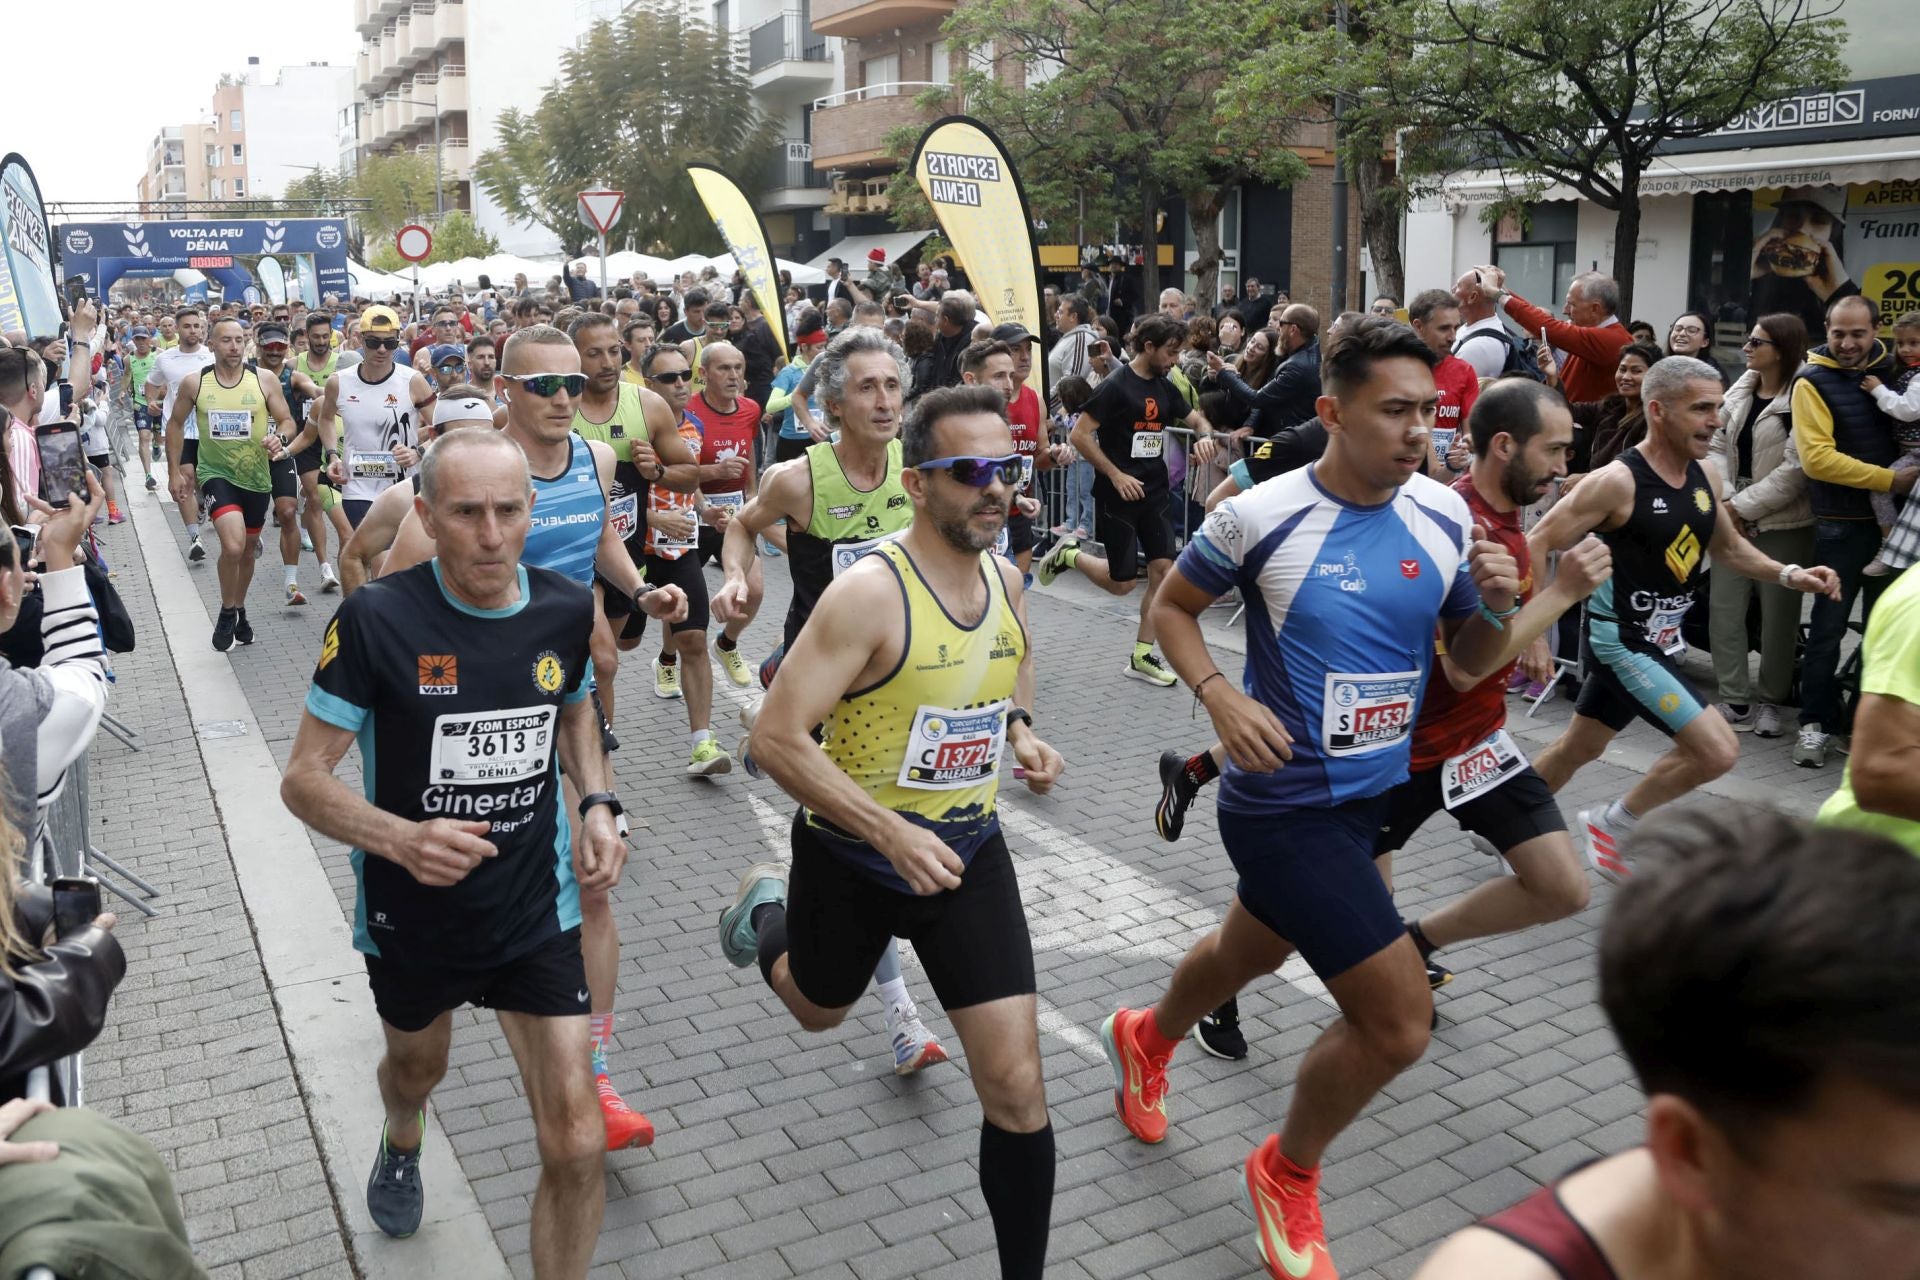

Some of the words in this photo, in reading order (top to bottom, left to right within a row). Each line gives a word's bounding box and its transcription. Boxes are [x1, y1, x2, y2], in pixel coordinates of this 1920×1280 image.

[790, 145, 810, 159] ART
[1690, 174, 1755, 190] PASTELERÍA
[1768, 171, 1831, 185] CAFETERÍA
[169, 229, 207, 238] VOLTA
[209, 229, 218, 238] A
[220, 228, 244, 238] PEU
[186, 239, 229, 251] DÉNIA
[421, 686, 456, 694] VAPF
[477, 720, 505, 733] SOM
[1339, 714, 1349, 732] S
[1358, 708, 1404, 733] 1453
[1353, 727, 1400, 744] BALEARIA
[468, 732, 526, 757] 3613
[921, 749, 935, 766] C
[940, 742, 987, 768] 1372
[478, 765, 518, 778] DÉNIA
[933, 765, 981, 780] BALEARIA
[1450, 772, 1456, 785] S
[1459, 755, 1495, 781] 1376
[1461, 768, 1503, 793] BALEARIA
[421, 780, 546, 815] Ginestar
